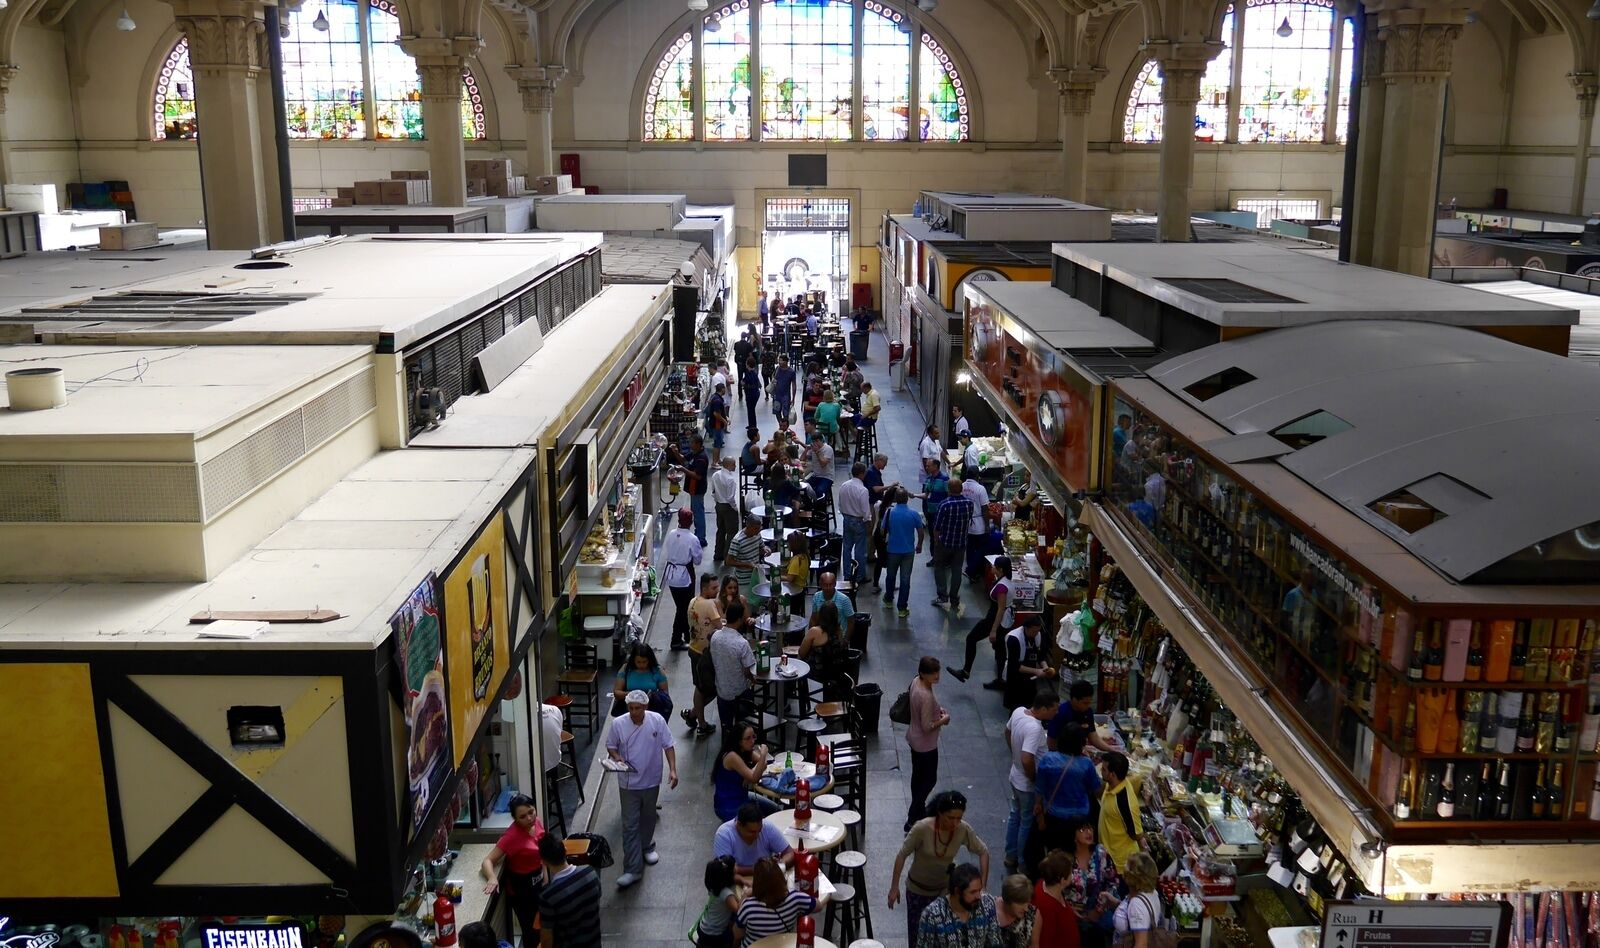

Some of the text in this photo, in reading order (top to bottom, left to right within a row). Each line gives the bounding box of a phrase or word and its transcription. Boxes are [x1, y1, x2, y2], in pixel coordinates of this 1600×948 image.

[1332, 910, 1383, 924] Rua H
[206, 926, 303, 948] EISENBAHN
[1364, 932, 1391, 940] Frutas
